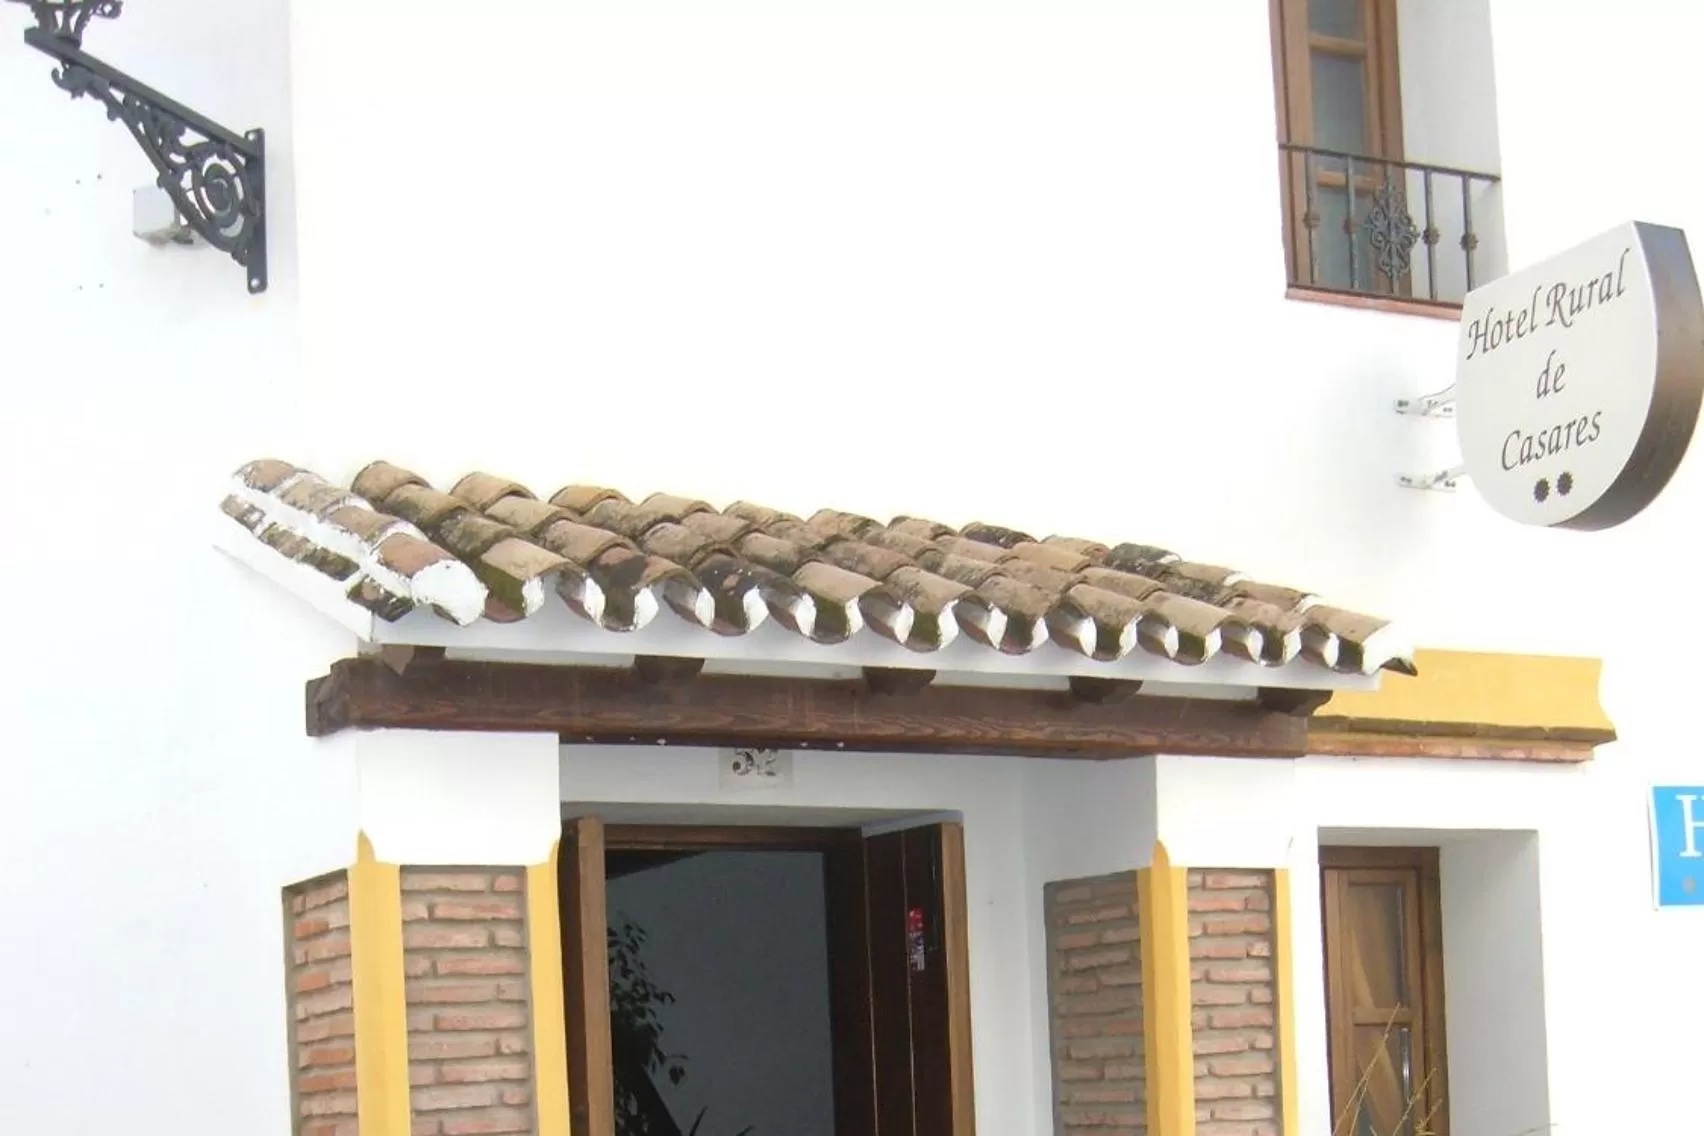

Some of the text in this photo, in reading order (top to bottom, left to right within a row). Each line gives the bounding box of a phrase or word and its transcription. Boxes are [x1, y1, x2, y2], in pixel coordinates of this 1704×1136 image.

[1466, 247, 1630, 361] Hotel Rural
[1535, 349, 1567, 400] de
[1501, 410, 1603, 472] Casares
